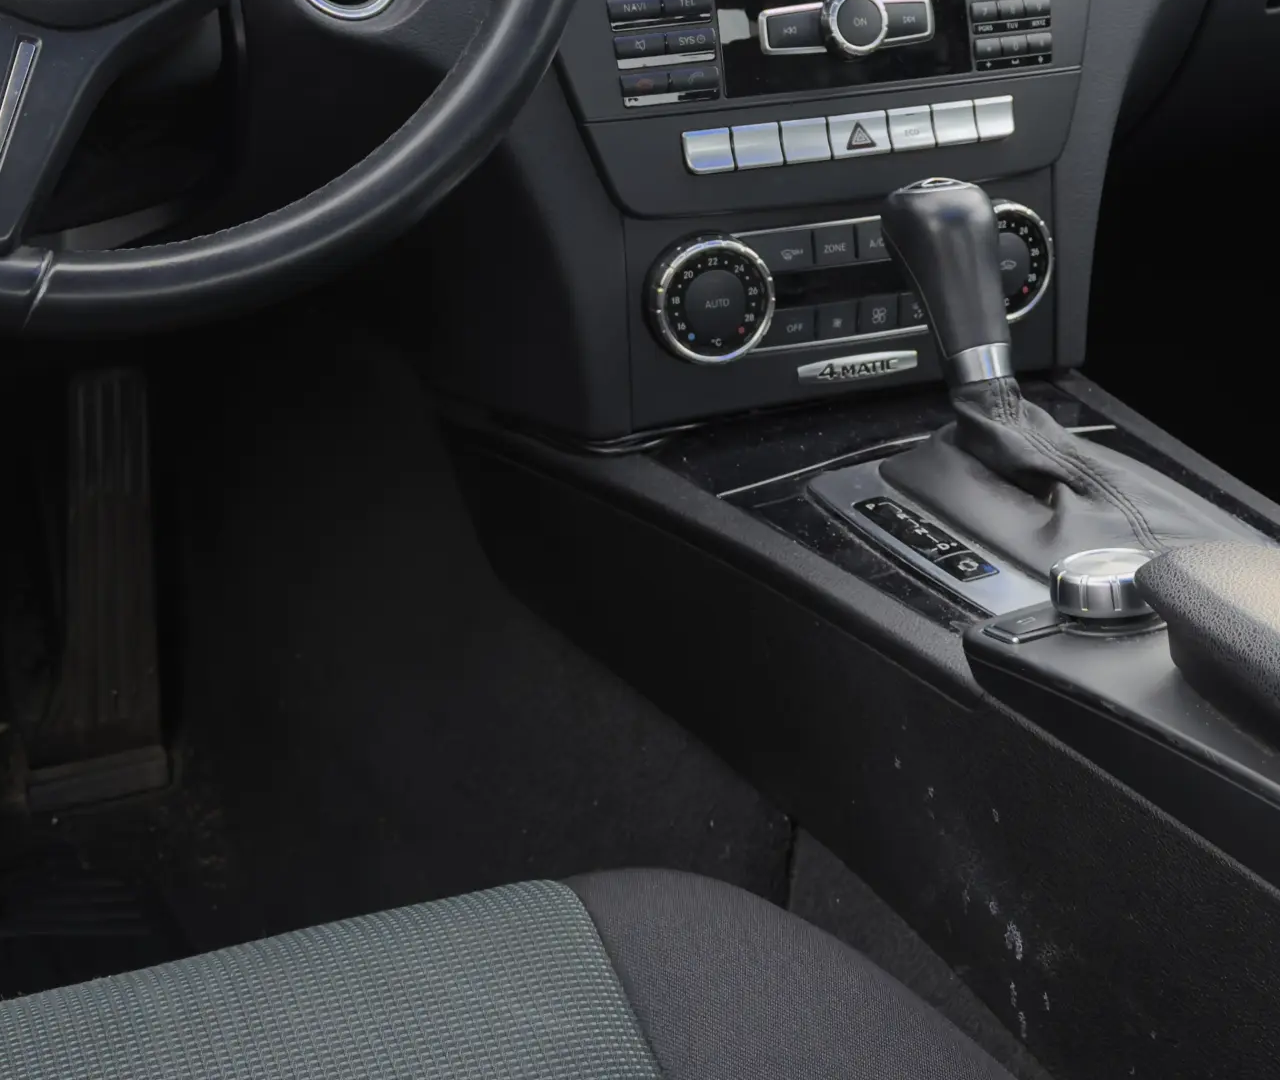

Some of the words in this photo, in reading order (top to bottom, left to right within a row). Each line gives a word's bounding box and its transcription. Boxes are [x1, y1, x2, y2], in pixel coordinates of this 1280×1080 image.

[623, 3, 647, 13] NAVI
[853, 16, 868, 27] ON
[679, 36, 696, 46] SYS
[904, 128, 920, 137] ECO
[824, 243, 846, 254] ZONE
[708, 257, 719, 266] 22
[734, 264, 745, 273] 24
[683, 270, 694, 279] 20
[748, 287, 758, 296] 26
[671, 296, 680, 305] 18
[705, 298, 730, 309] AUTO
[744, 314, 755, 323] 28
[677, 322, 686, 331] 16
[786, 323, 803, 333] OFF
